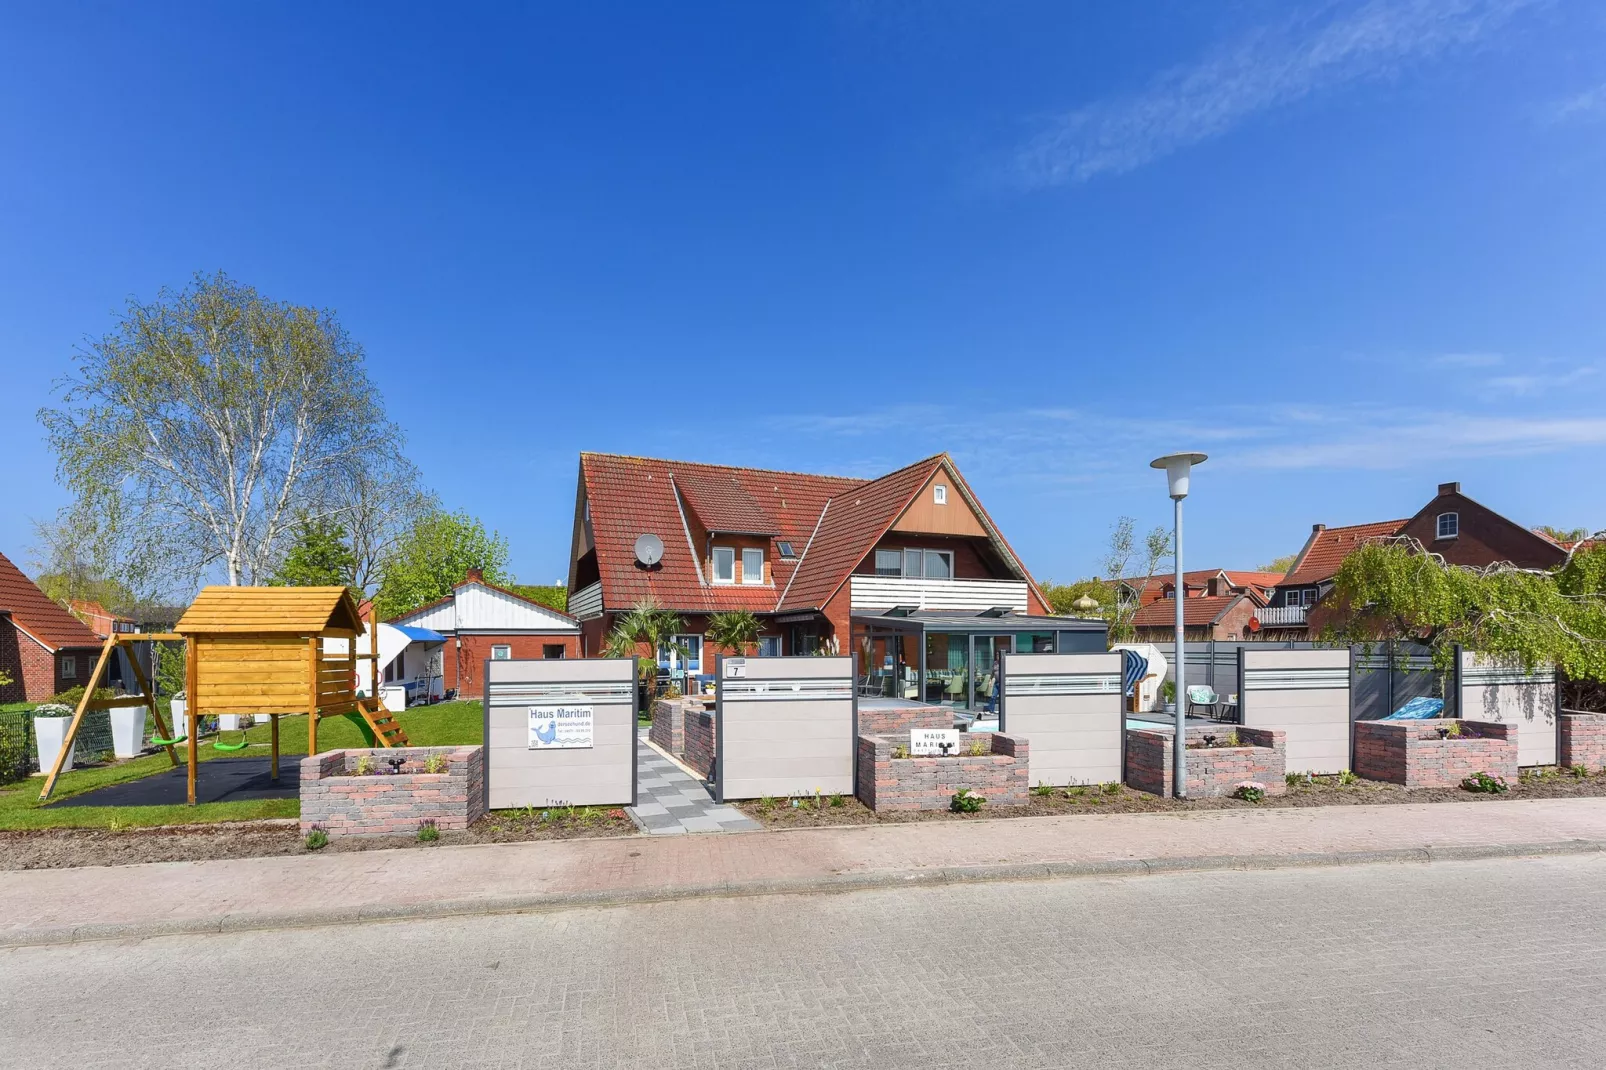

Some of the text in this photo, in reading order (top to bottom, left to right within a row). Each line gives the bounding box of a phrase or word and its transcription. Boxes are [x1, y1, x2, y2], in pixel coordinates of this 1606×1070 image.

[733, 667, 739, 676] 7
[530, 708, 591, 719] Haus Maritim
